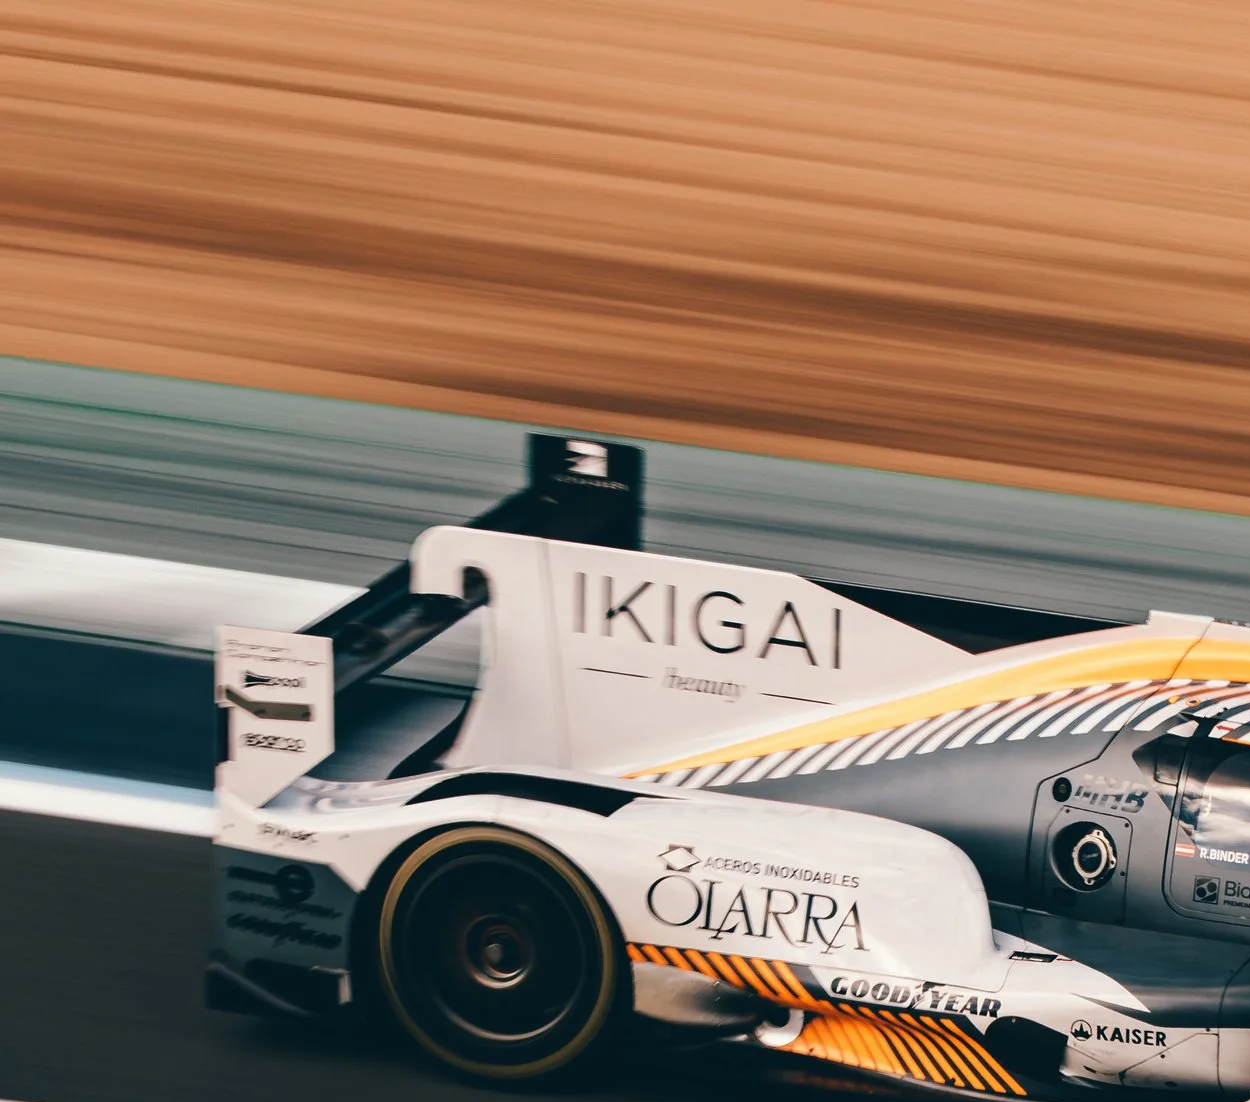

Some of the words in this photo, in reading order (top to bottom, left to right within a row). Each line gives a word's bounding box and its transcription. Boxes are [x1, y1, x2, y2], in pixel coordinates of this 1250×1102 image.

[573, 571, 842, 670] IKIGAI
[703, 856, 761, 875] ACEROS
[764, 864, 861, 889] INOXIDABLES
[1200, 847, 1249, 865] R.BINDER
[647, 874, 870, 955] OLARRA
[1223, 900, 1250, 909] PREMIUM
[830, 976, 1001, 1018] GOODYEAR
[1096, 1025, 1167, 1047] KAISER
